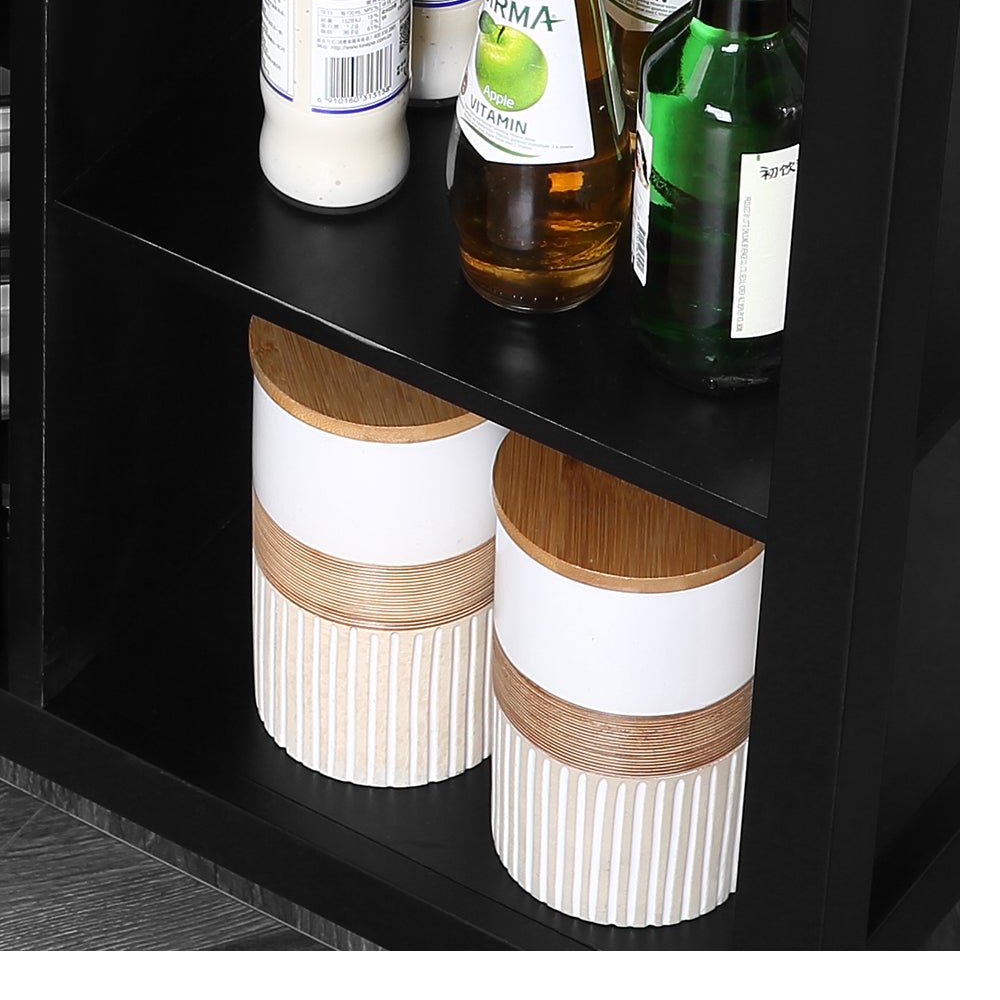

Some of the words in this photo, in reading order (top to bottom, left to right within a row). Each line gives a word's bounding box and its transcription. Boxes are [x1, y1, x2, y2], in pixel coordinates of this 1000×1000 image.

[483, 85, 515, 109] Apple
[470, 93, 528, 135] VITAMIN
[760, 161, 797, 180] 初饮
